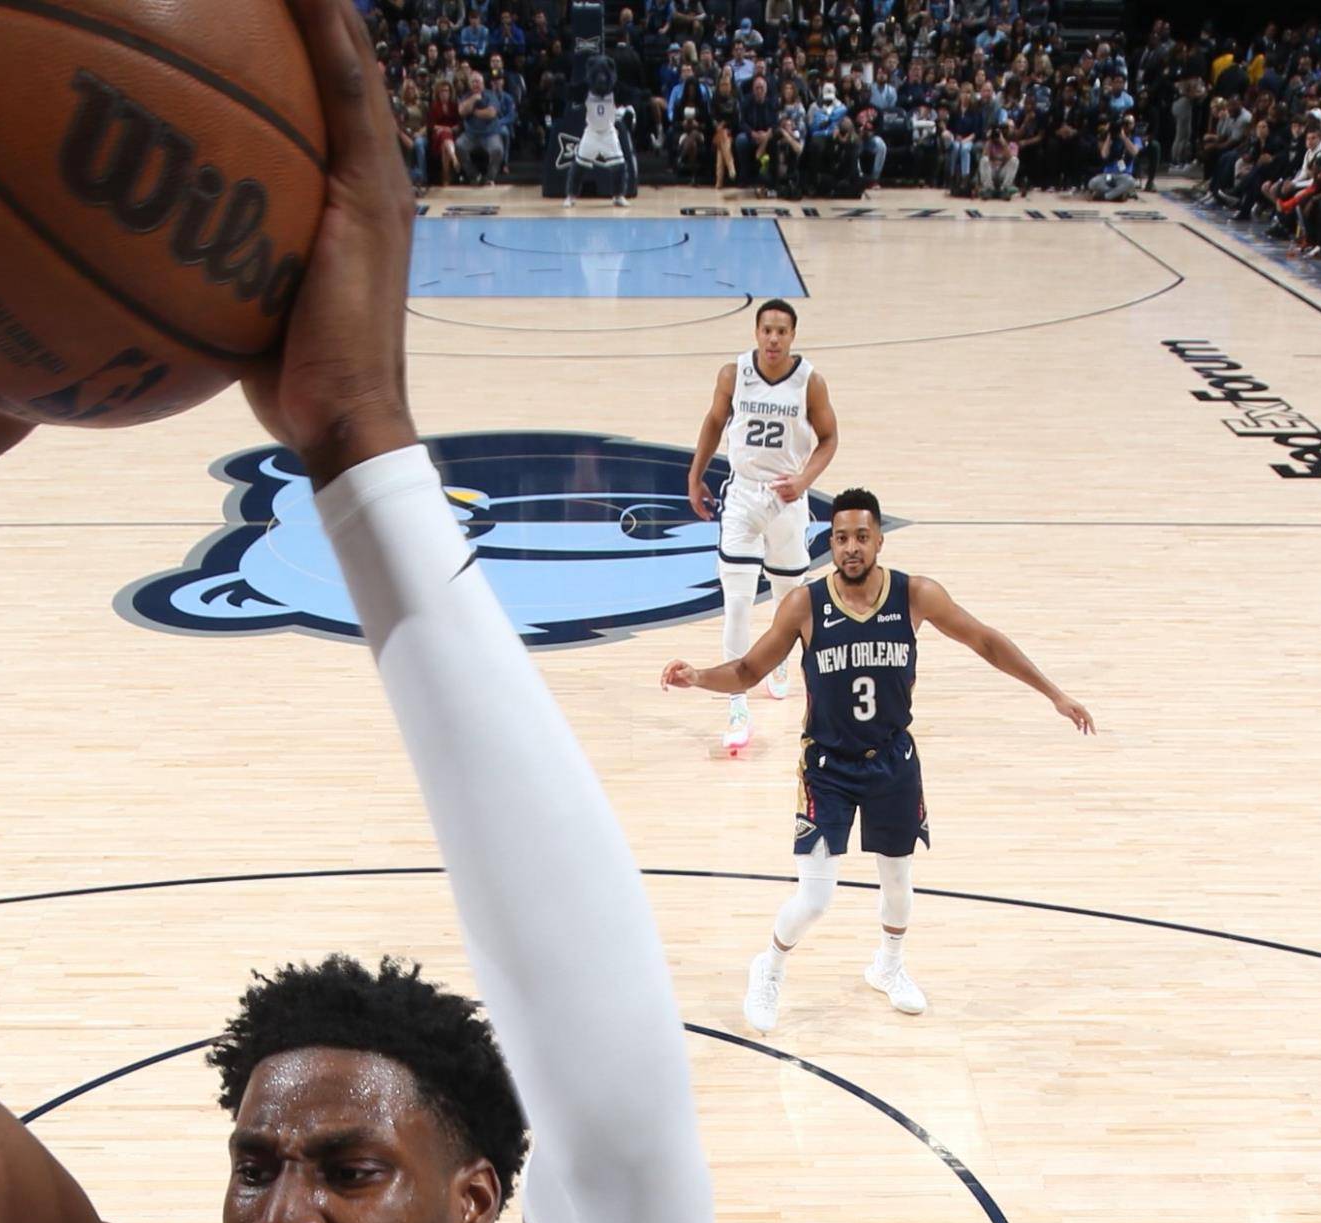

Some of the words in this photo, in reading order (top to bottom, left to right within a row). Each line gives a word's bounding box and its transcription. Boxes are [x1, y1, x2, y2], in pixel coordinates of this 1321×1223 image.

[680, 206, 1167, 222] GRIZZLIES
[739, 400, 800, 418] MEMPHIS
[745, 419, 785, 449] 22
[815, 644, 849, 674] NEW
[851, 641, 910, 668] ORLEANS
[852, 676, 877, 722] 3
